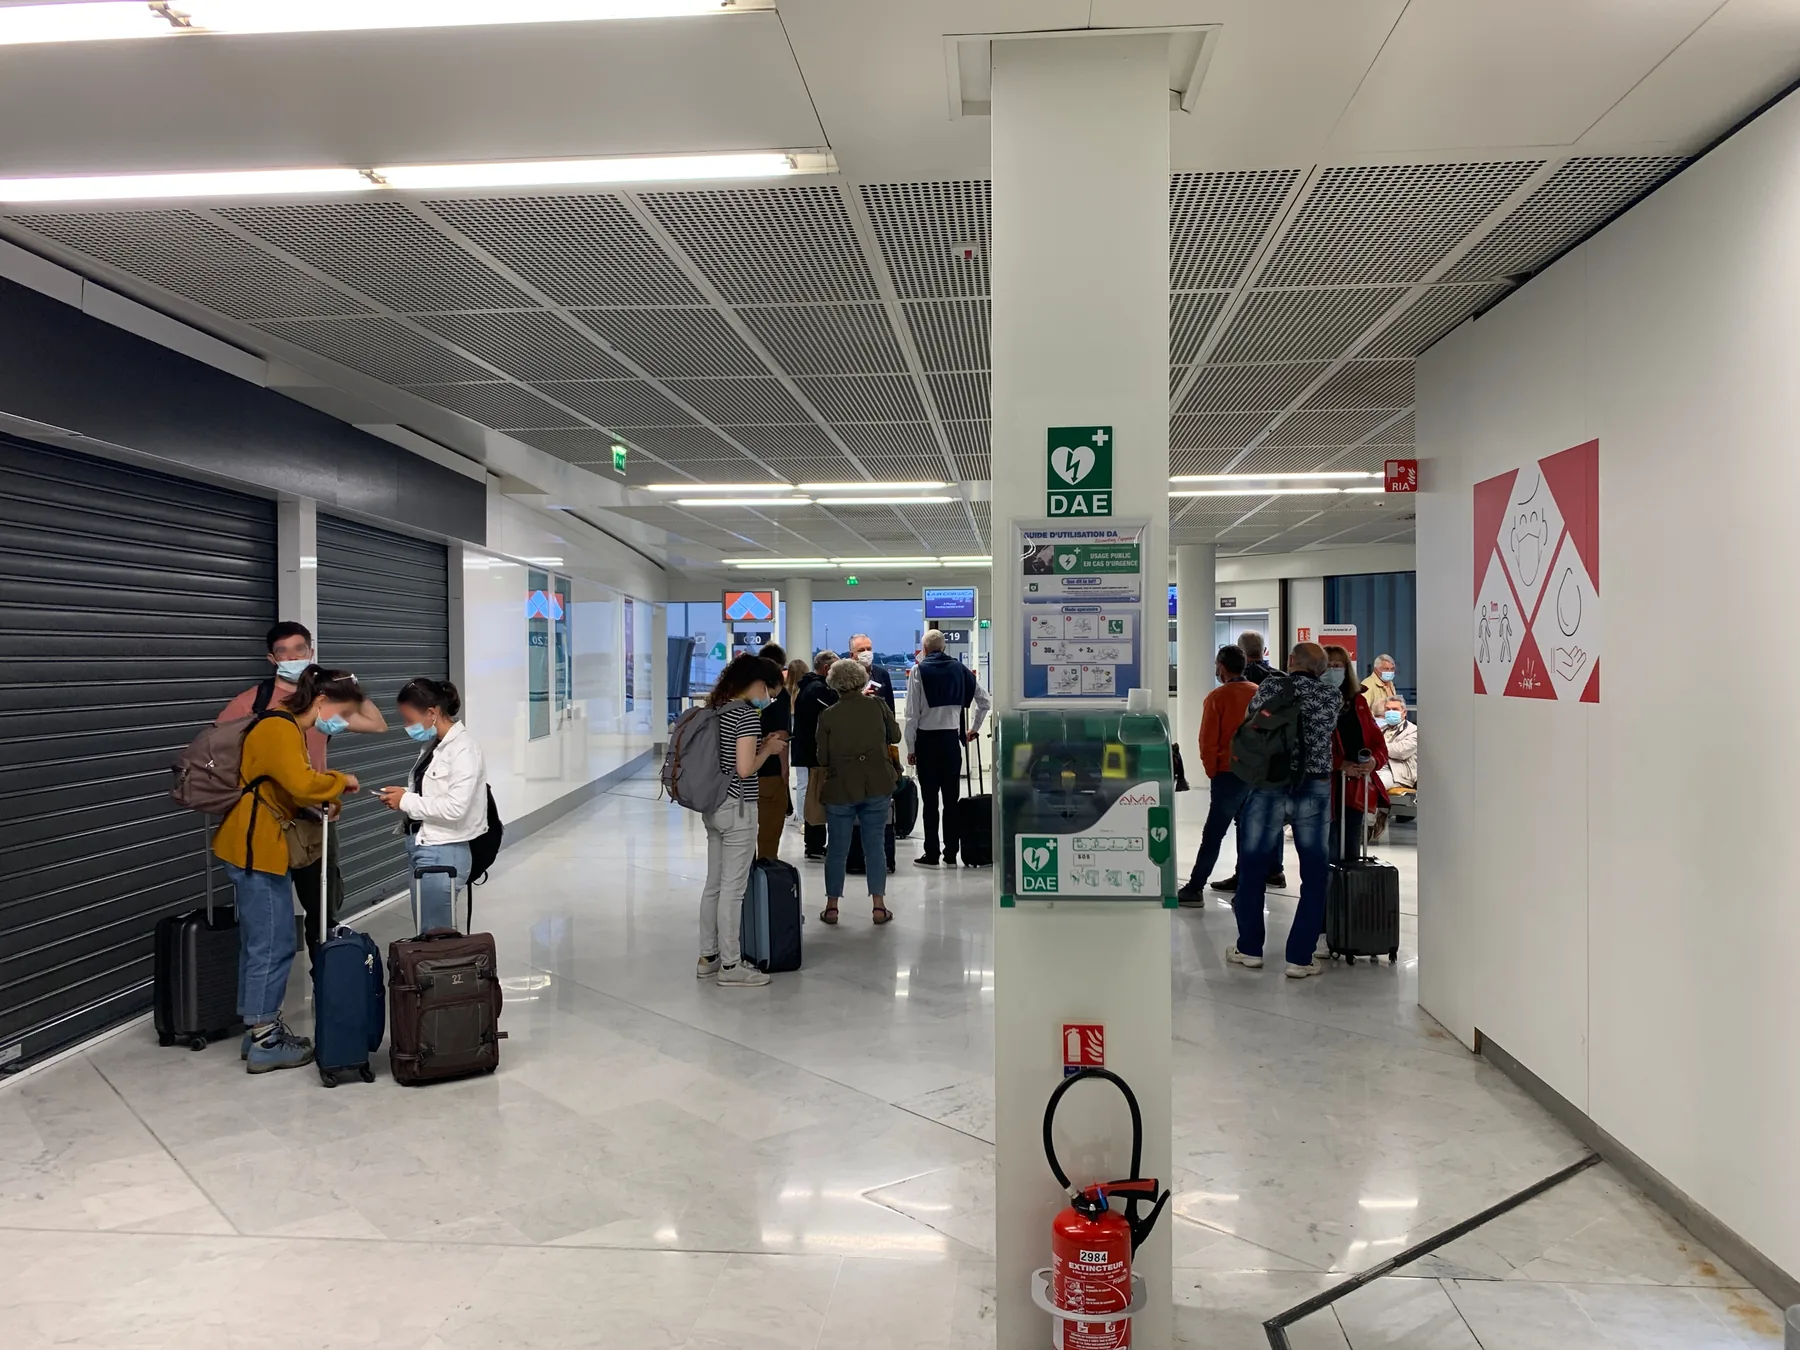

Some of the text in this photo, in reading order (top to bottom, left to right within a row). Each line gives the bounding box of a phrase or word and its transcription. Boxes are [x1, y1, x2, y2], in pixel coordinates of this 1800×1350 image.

[1392, 482, 1410, 491] RIA
[1050, 494, 1109, 514] DAE
[1024, 876, 1056, 890] DAE
[1081, 1252, 1106, 1262] 2984
[1068, 1261, 1123, 1272] EXTINCTEUR
